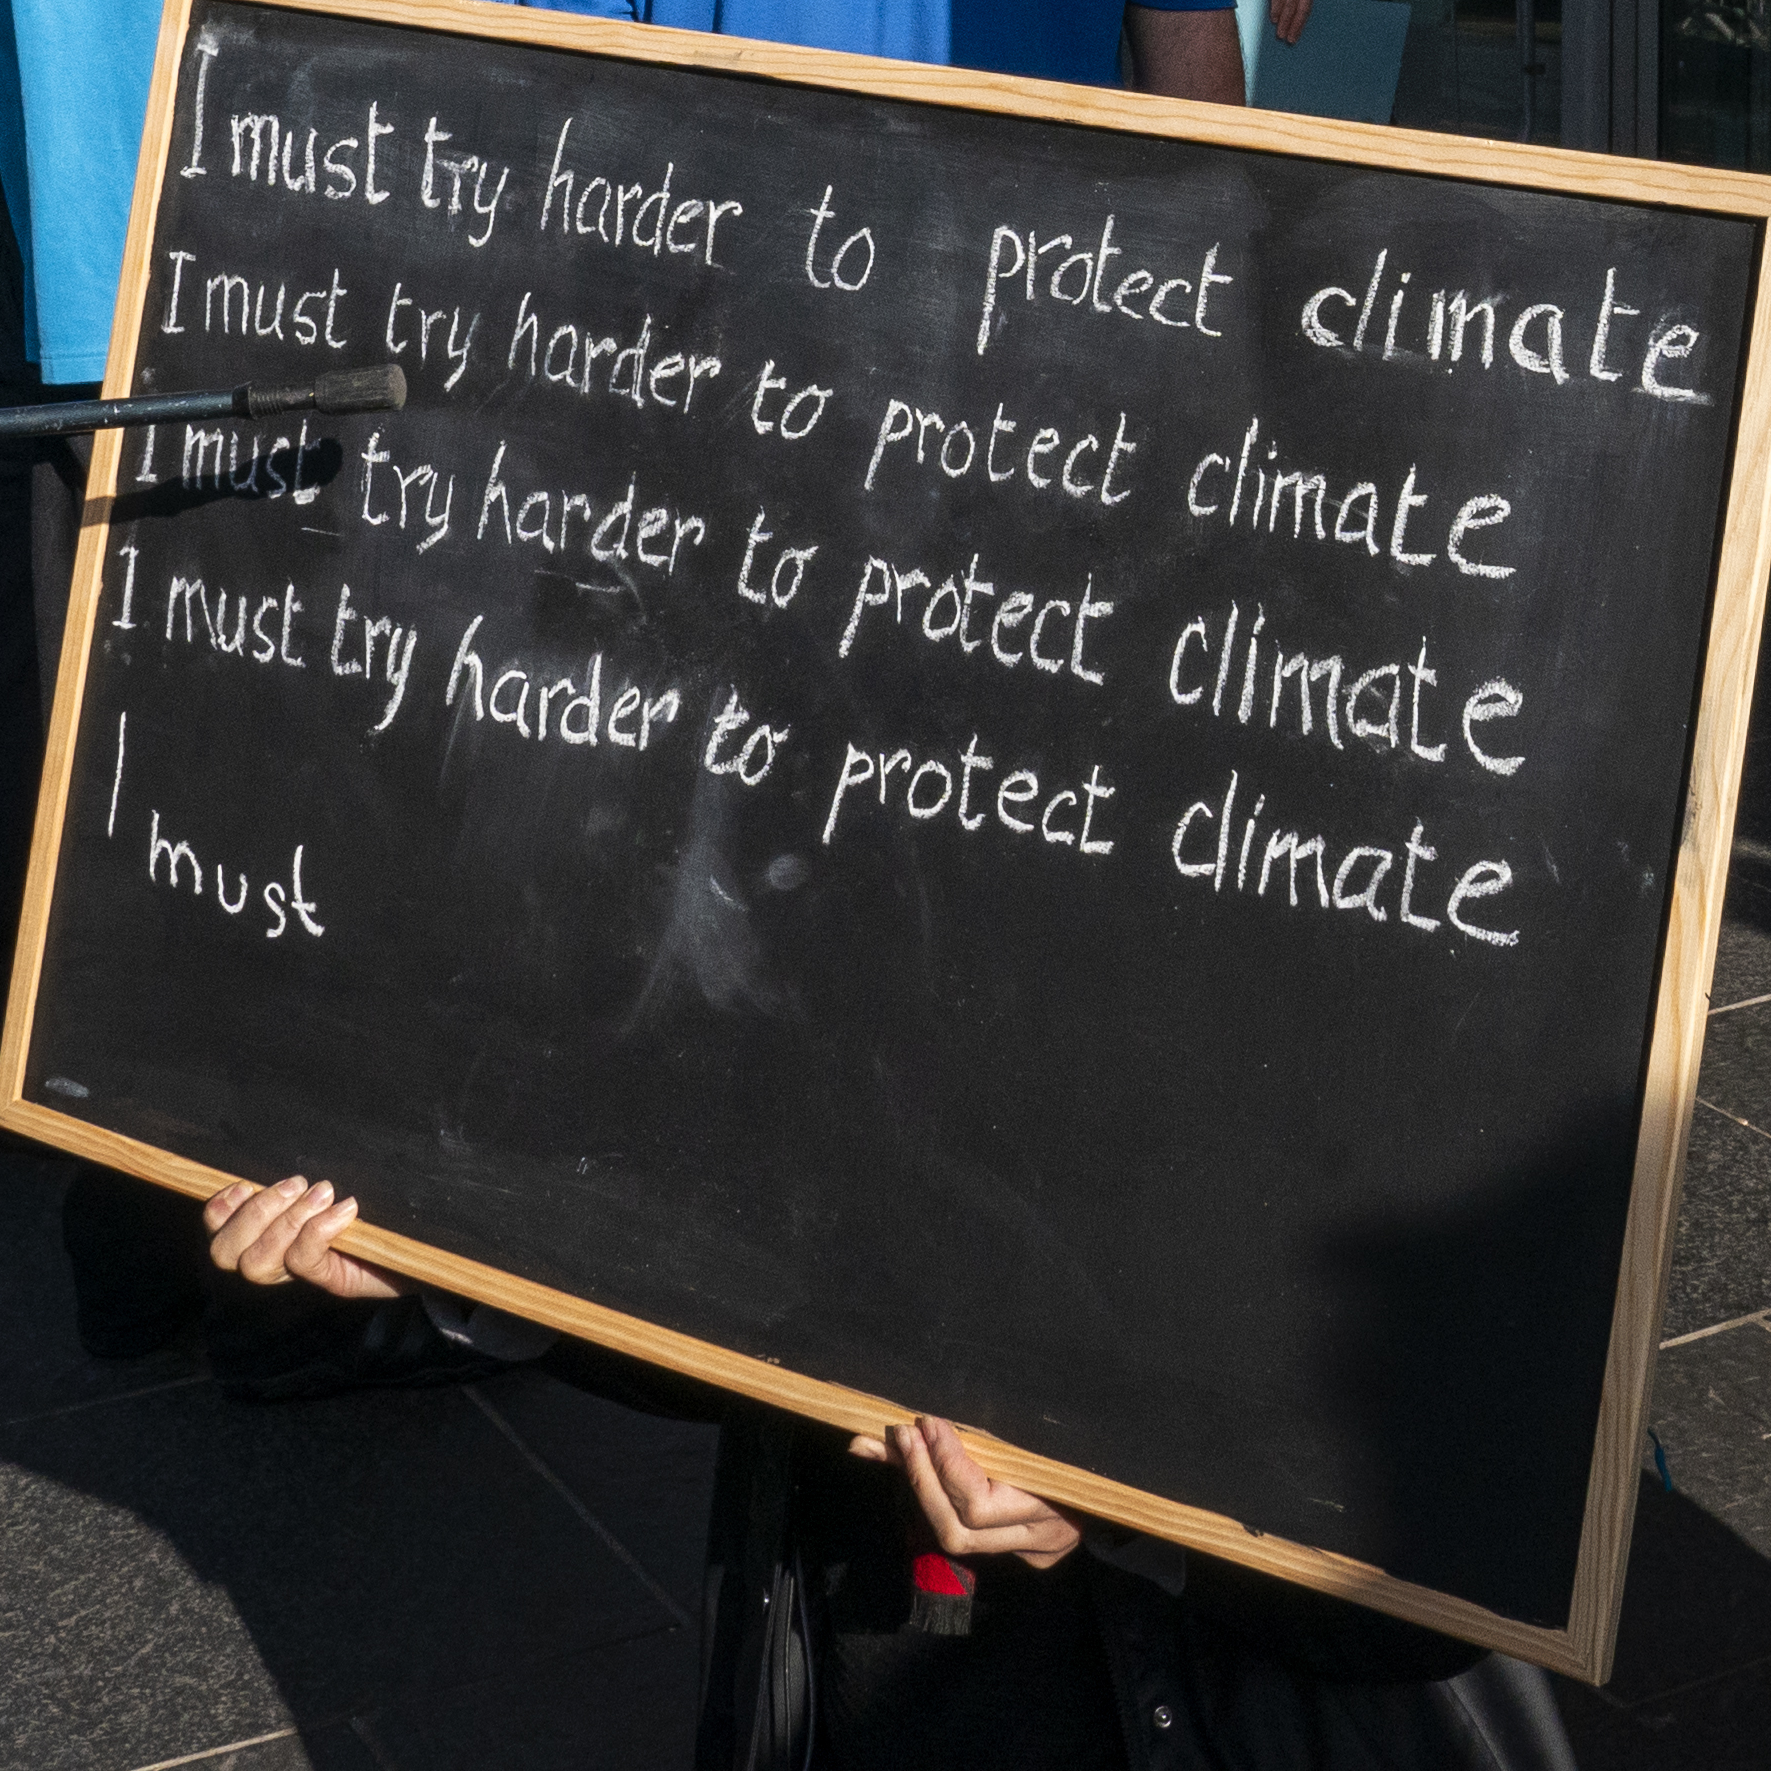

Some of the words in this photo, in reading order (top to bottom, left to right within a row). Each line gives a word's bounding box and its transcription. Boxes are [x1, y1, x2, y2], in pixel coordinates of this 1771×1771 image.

[180, 42, 218, 177] I
[231, 101, 394, 206] must
[421, 117, 509, 248] try
[542, 117, 743, 267] harder
[805, 185, 875, 291] to
[979, 214, 1233, 355] protect
[1301, 247, 1713, 402] climate
[161, 250, 196, 334] I
[206, 268, 349, 349] must
[386, 282, 481, 393] try
[508, 292, 722, 414] harder
[752, 359, 833, 439] to
[865, 396, 1135, 507] protect
[1187, 414, 1518, 580] climate
[111, 546, 140, 628] I
[166, 570, 307, 670] must
[330, 585, 417, 734] try
[445, 614, 679, 750] harder
[704, 685, 789, 785] to
[823, 733, 1115, 855] protect
[1171, 770, 1522, 946] climate
[181, 418, 322, 504] must
[361, 431, 454, 555] try
[477, 440, 705, 576] harder
[737, 505, 819, 607] to
[839, 554, 1115, 685] protect
[1170, 599, 1526, 777] climate
[149, 810, 326, 938] must
